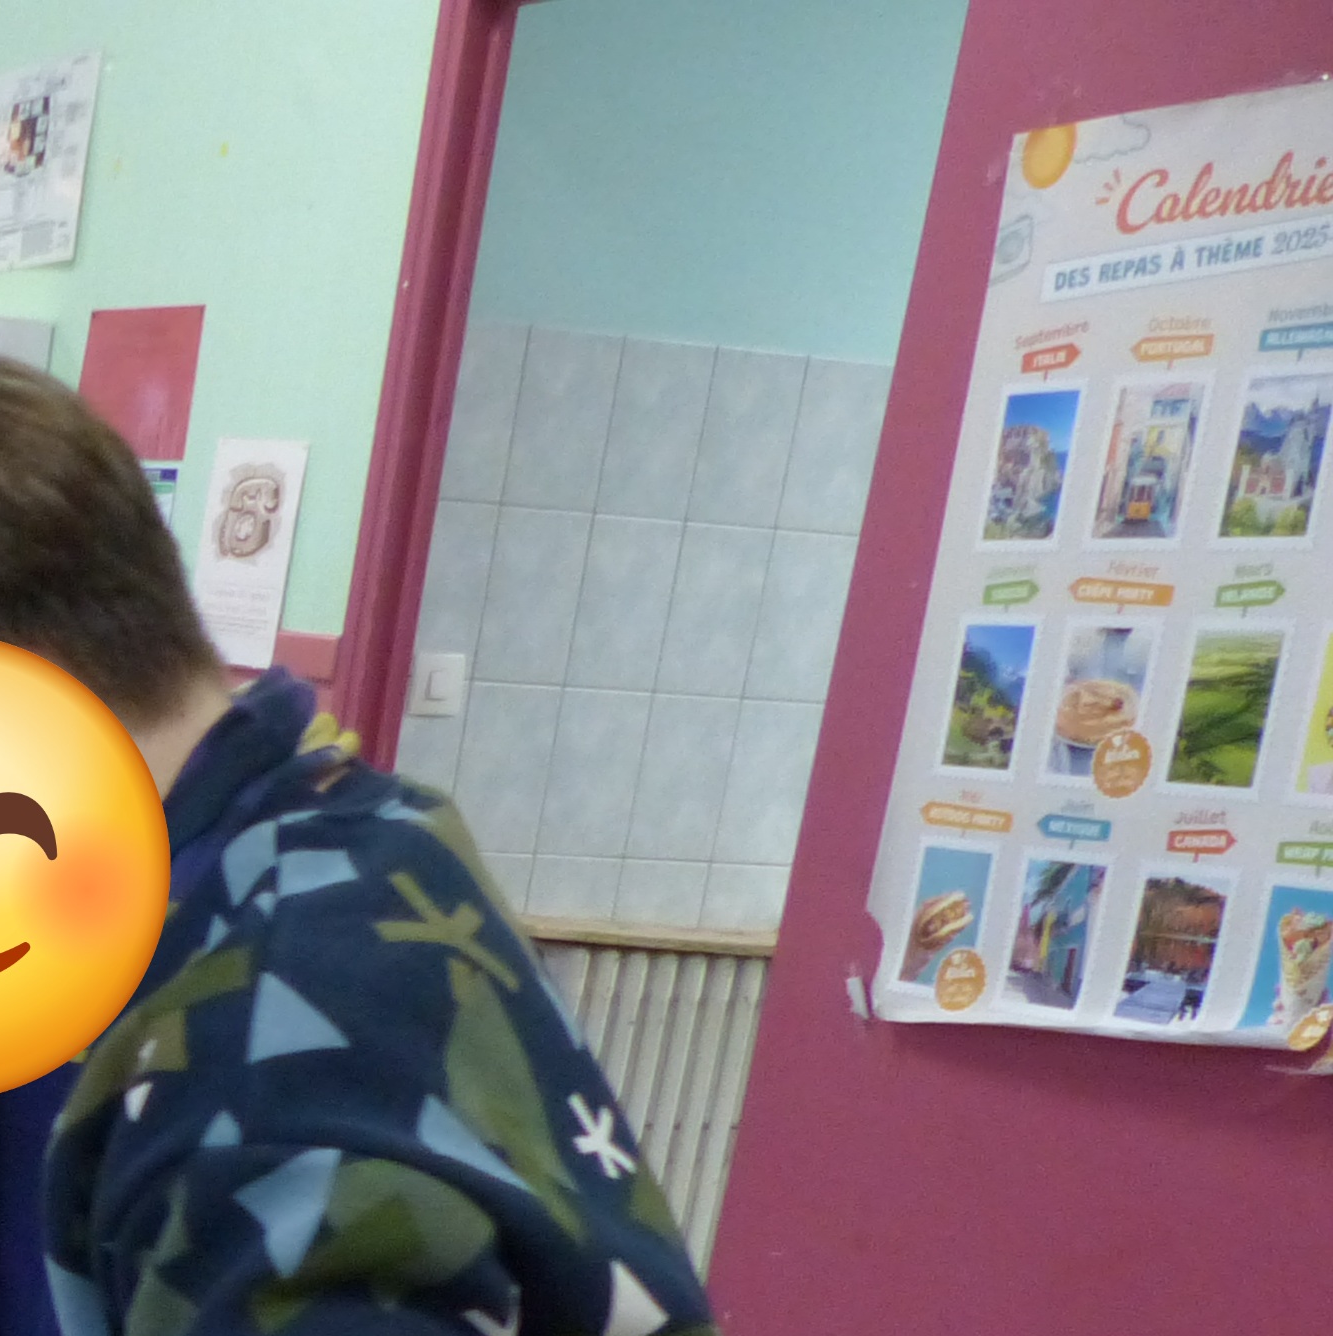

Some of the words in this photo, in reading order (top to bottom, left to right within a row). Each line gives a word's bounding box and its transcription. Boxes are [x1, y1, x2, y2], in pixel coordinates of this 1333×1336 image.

[1054, 265, 1091, 292] DES
[1099, 253, 1162, 284] REPAS
[1170, 245, 1186, 273] À
[1195, 235, 1265, 268] THÈME
[1174, 809, 1227, 826] Juillet
